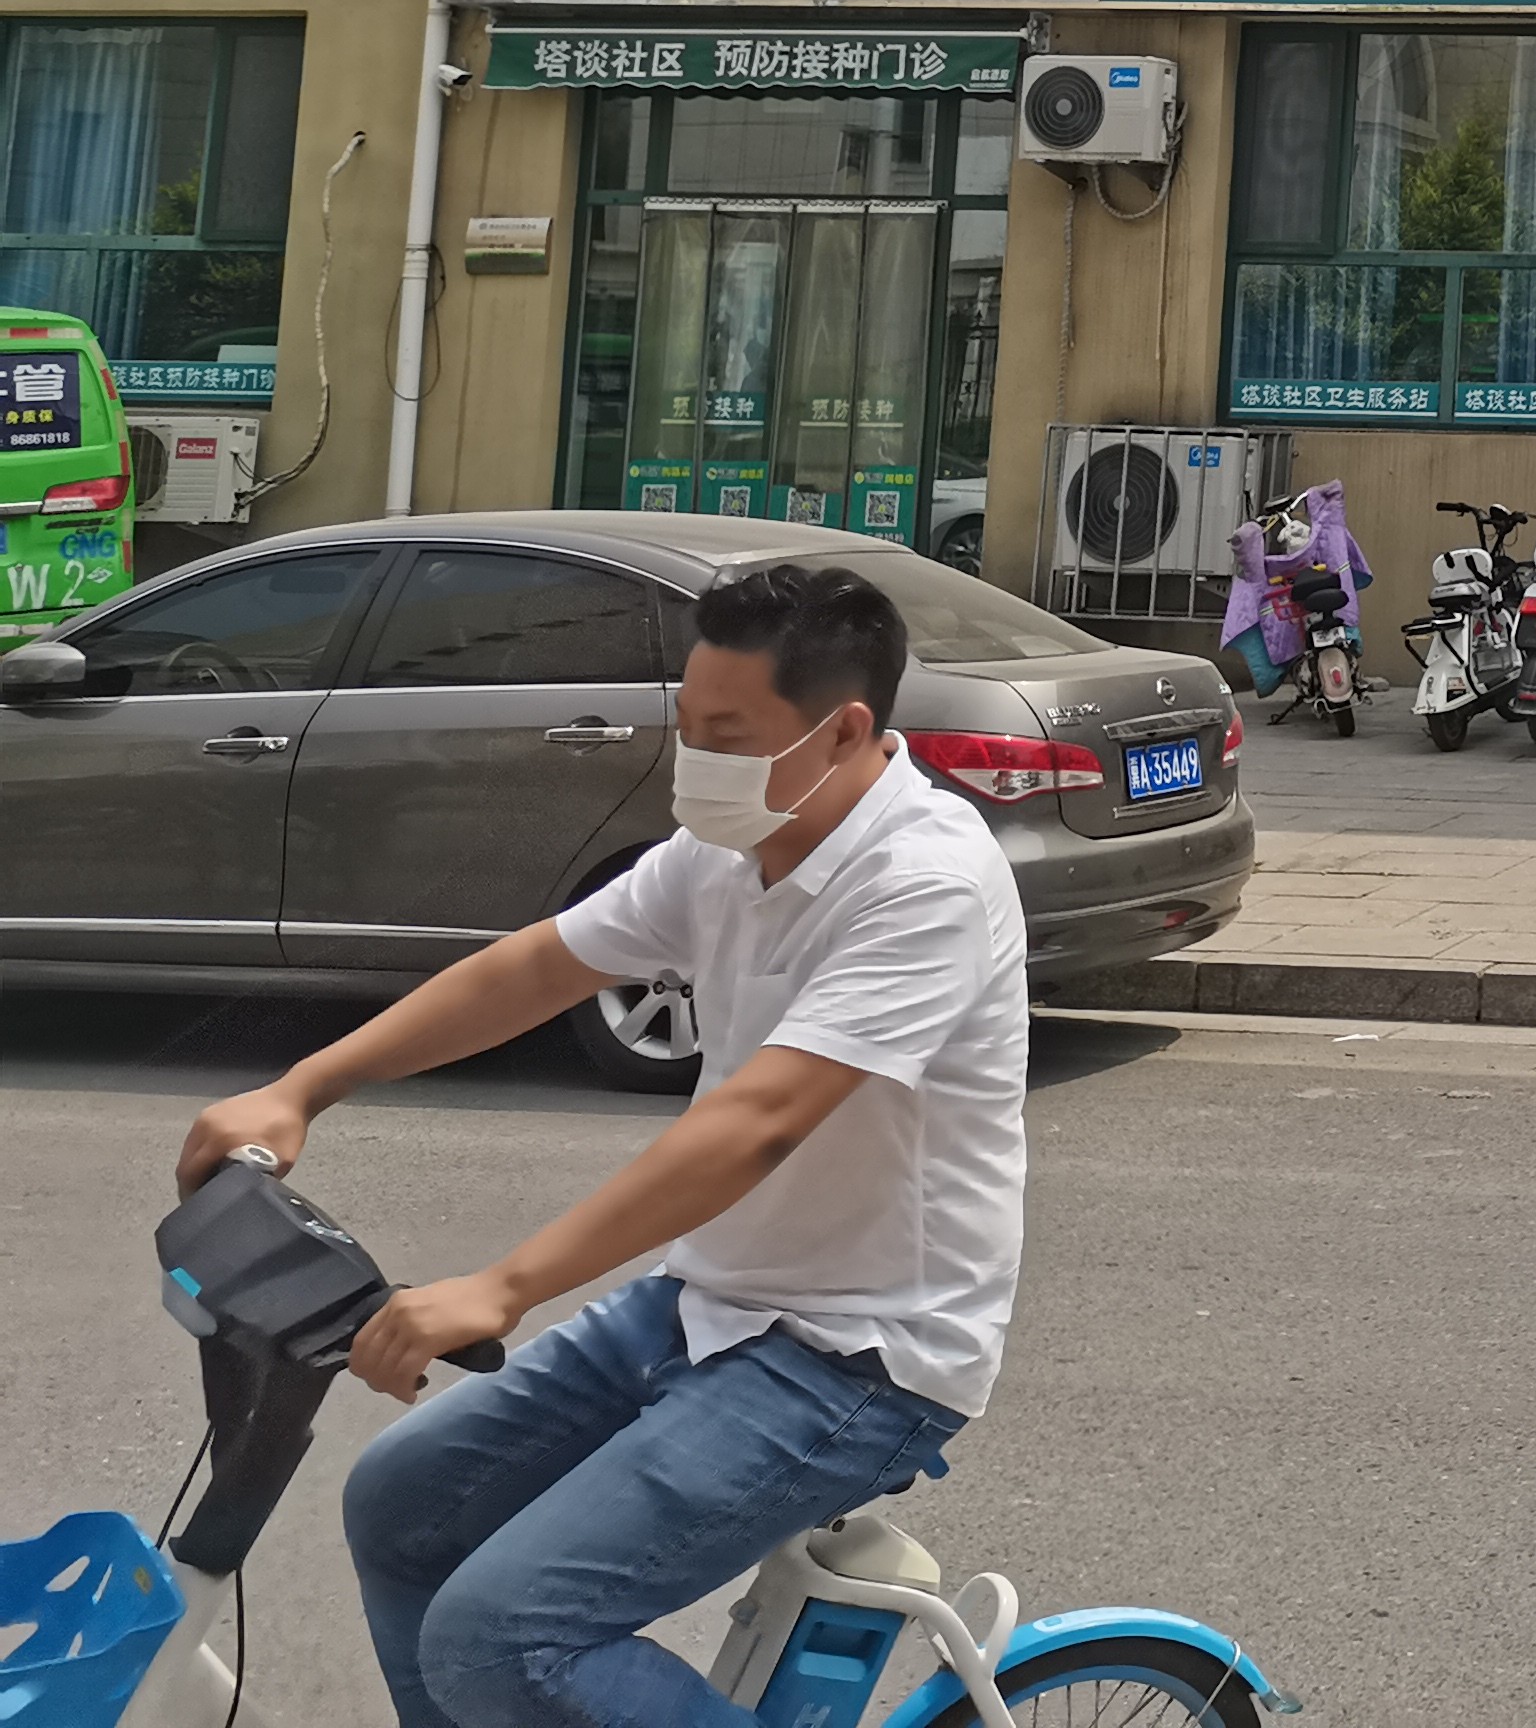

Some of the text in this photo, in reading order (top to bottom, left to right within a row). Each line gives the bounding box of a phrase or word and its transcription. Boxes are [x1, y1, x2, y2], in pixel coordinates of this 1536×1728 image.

[533, 40, 687, 80] 塔谈社区
[714, 39, 949, 81] 预防接种门诊
[0, 363, 66, 403] 管
[1241, 384, 1430, 410] 塔谈社区卫生服务站
[10, 431, 71, 446] 86861818
